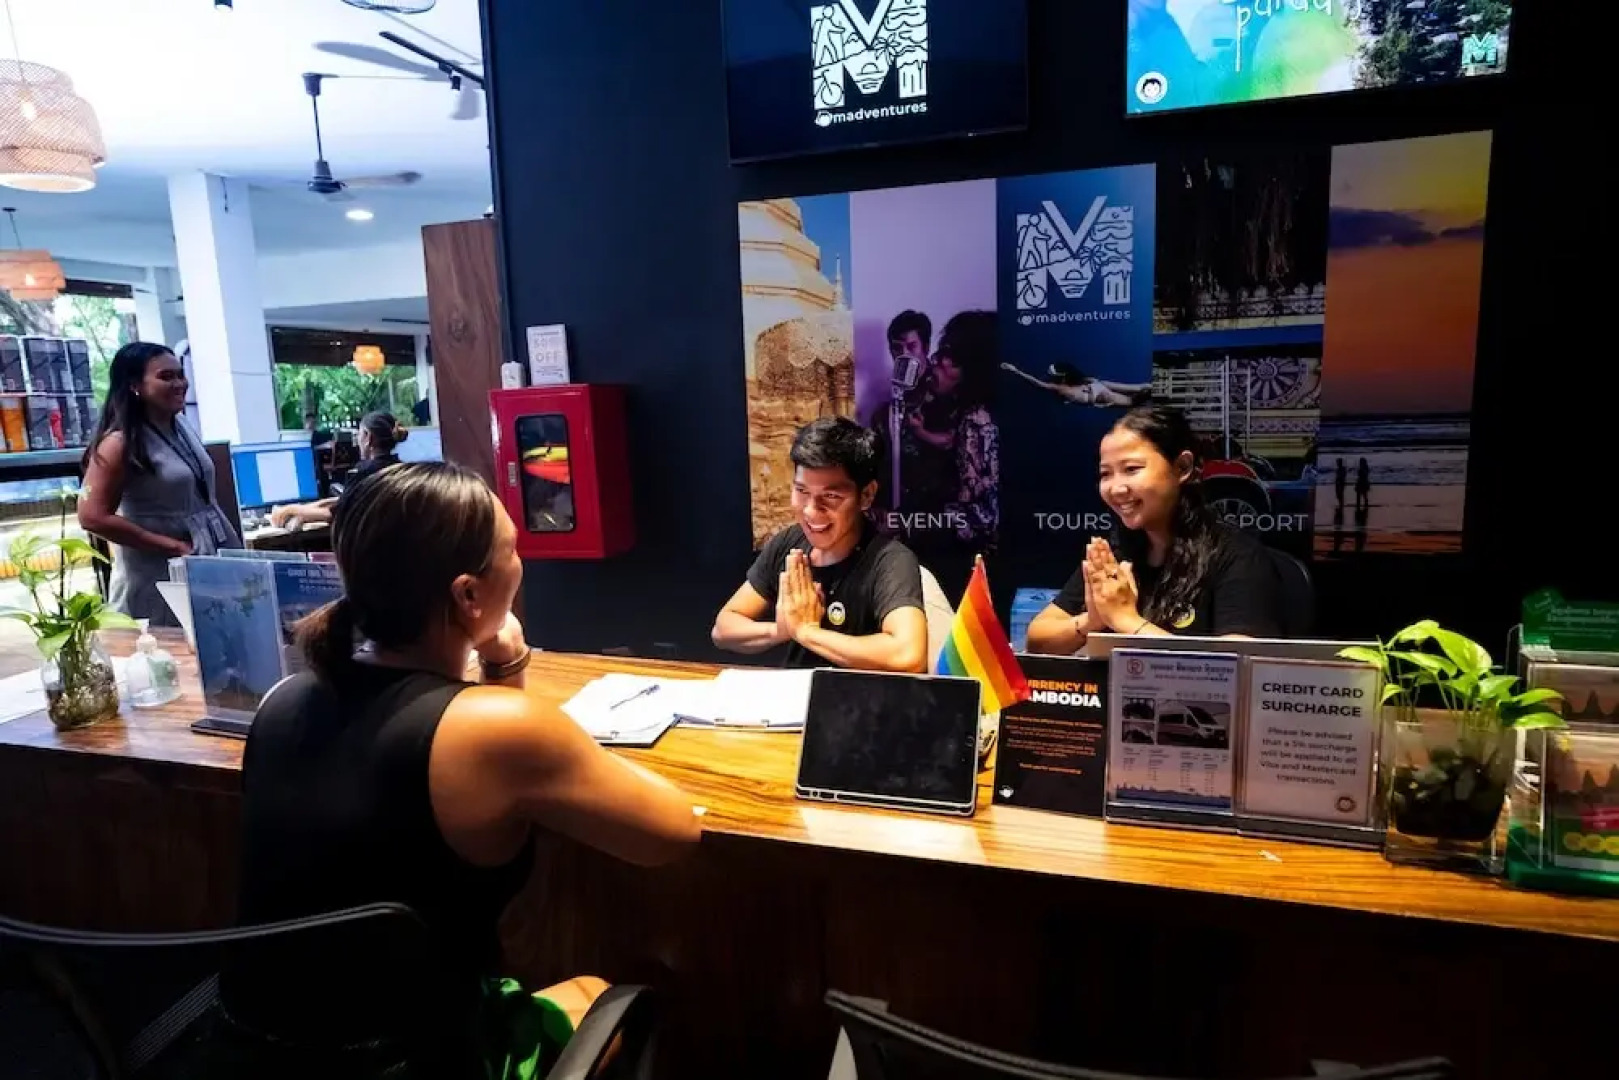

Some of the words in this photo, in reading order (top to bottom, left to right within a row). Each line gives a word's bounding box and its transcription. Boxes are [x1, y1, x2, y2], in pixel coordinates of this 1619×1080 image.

[832, 102, 928, 124] madventures
[1035, 310, 1132, 324] madventures
[886, 511, 968, 530] EVENTS
[1033, 512, 1113, 531] TOURS
[1084, 682, 1099, 694] IN
[1262, 682, 1316, 696] CREDIT
[1320, 686, 1364, 699] CARD
[1027, 690, 1102, 709] MBODIA
[1261, 700, 1362, 718] SURCHARGE
[1267, 727, 1298, 736] Please
[1301, 730, 1313, 738] be
[1315, 731, 1352, 741] advised
[1261, 749, 1278, 757] will
[1280, 750, 1291, 759] be
[1294, 753, 1330, 763] applied
[1333, 755, 1342, 763] to
[1308, 743, 1358, 754] surcharge
[1260, 760, 1280, 770] Visa
[1302, 763, 1356, 776] Mastercard
